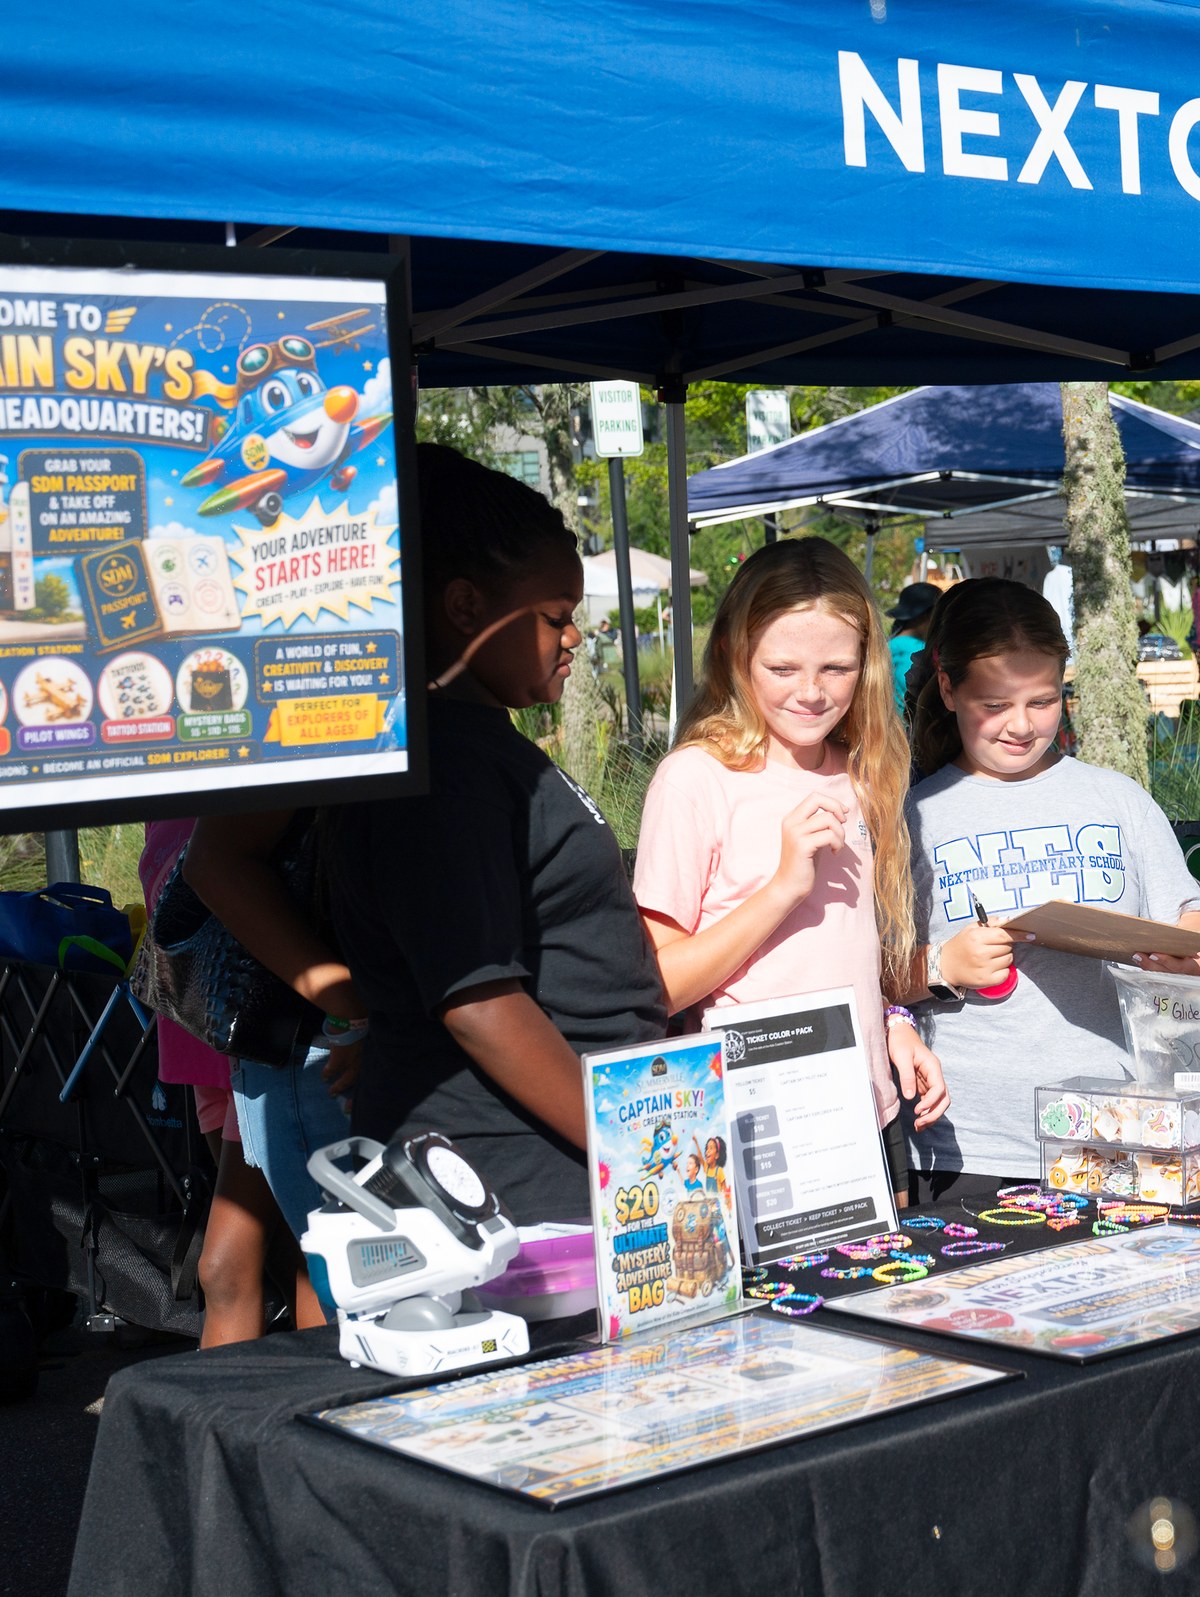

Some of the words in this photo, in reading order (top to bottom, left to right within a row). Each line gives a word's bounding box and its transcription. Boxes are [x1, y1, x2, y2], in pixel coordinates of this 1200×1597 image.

[63, 303, 102, 331] TO
[0, 335, 54, 388] IN
[64, 337, 194, 400] SKY’S
[599, 390, 632, 403] VISITOR
[0, 398, 205, 443] EADQUARTERS!
[600, 419, 637, 432] PARKING
[45, 460, 78, 472] GRAB
[79, 458, 111, 471] YOUR
[31, 476, 63, 493] SDM
[67, 475, 137, 491] PASSPORT
[49, 496, 59, 509] &
[61, 496, 91, 509] TAKE
[93, 495, 116, 508] OFF
[39, 512, 58, 525] ON
[60, 512, 77, 525] AN
[79, 511, 131, 524] AMAZING
[49, 527, 125, 541] ADVENTURE!
[252, 537, 287, 562] YOUR
[291, 522, 367, 550] ADVENTURE
[102, 564, 134, 587] SDM
[255, 551, 321, 592] STARTS
[328, 544, 375, 573] HERE!
[101, 592, 148, 615] PASSPORT
[276, 648, 284, 660] A
[285, 645, 323, 659] WORLD
[324, 644, 337, 657] OF
[294, 700, 337, 711] PERFECT
[342, 698, 361, 708] FOR
[288, 712, 350, 726] EXPLORERS
[355, 710, 369, 720] OF
[24, 730, 53, 744] PILOT
[55, 727, 90, 741] WINGS
[300, 727, 321, 738] ALL
[148, 753, 171, 765] SDM
[933, 824, 1126, 922] NES
[939, 867, 989, 889] NEXTON
[993, 856, 1085, 876] ELEMENTARY
[1089, 856, 1126, 871] SCHOOL
[1154, 996, 1168, 1013] 45
[746, 1033, 768, 1044] TICKET
[769, 1030, 790, 1039] COLOR
[796, 1026, 813, 1035] PACK
[619, 1092, 672, 1123] CAPTAIN
[675, 1090, 705, 1109] SKY!
[643, 1112, 672, 1127] CREATION
[674, 1110, 698, 1120] STATION
[615, 1182, 659, 1225] $20
[763, 1222, 785, 1232] COLLECT
[786, 1217, 802, 1227] TICKET
[822, 1209, 837, 1218] TICKET
[855, 1202, 868, 1210] PACK
[613, 1223, 668, 1254] ULTIMATE
[617, 1263, 672, 1292] ADVENTURE
[629, 1280, 665, 1314] BAG
